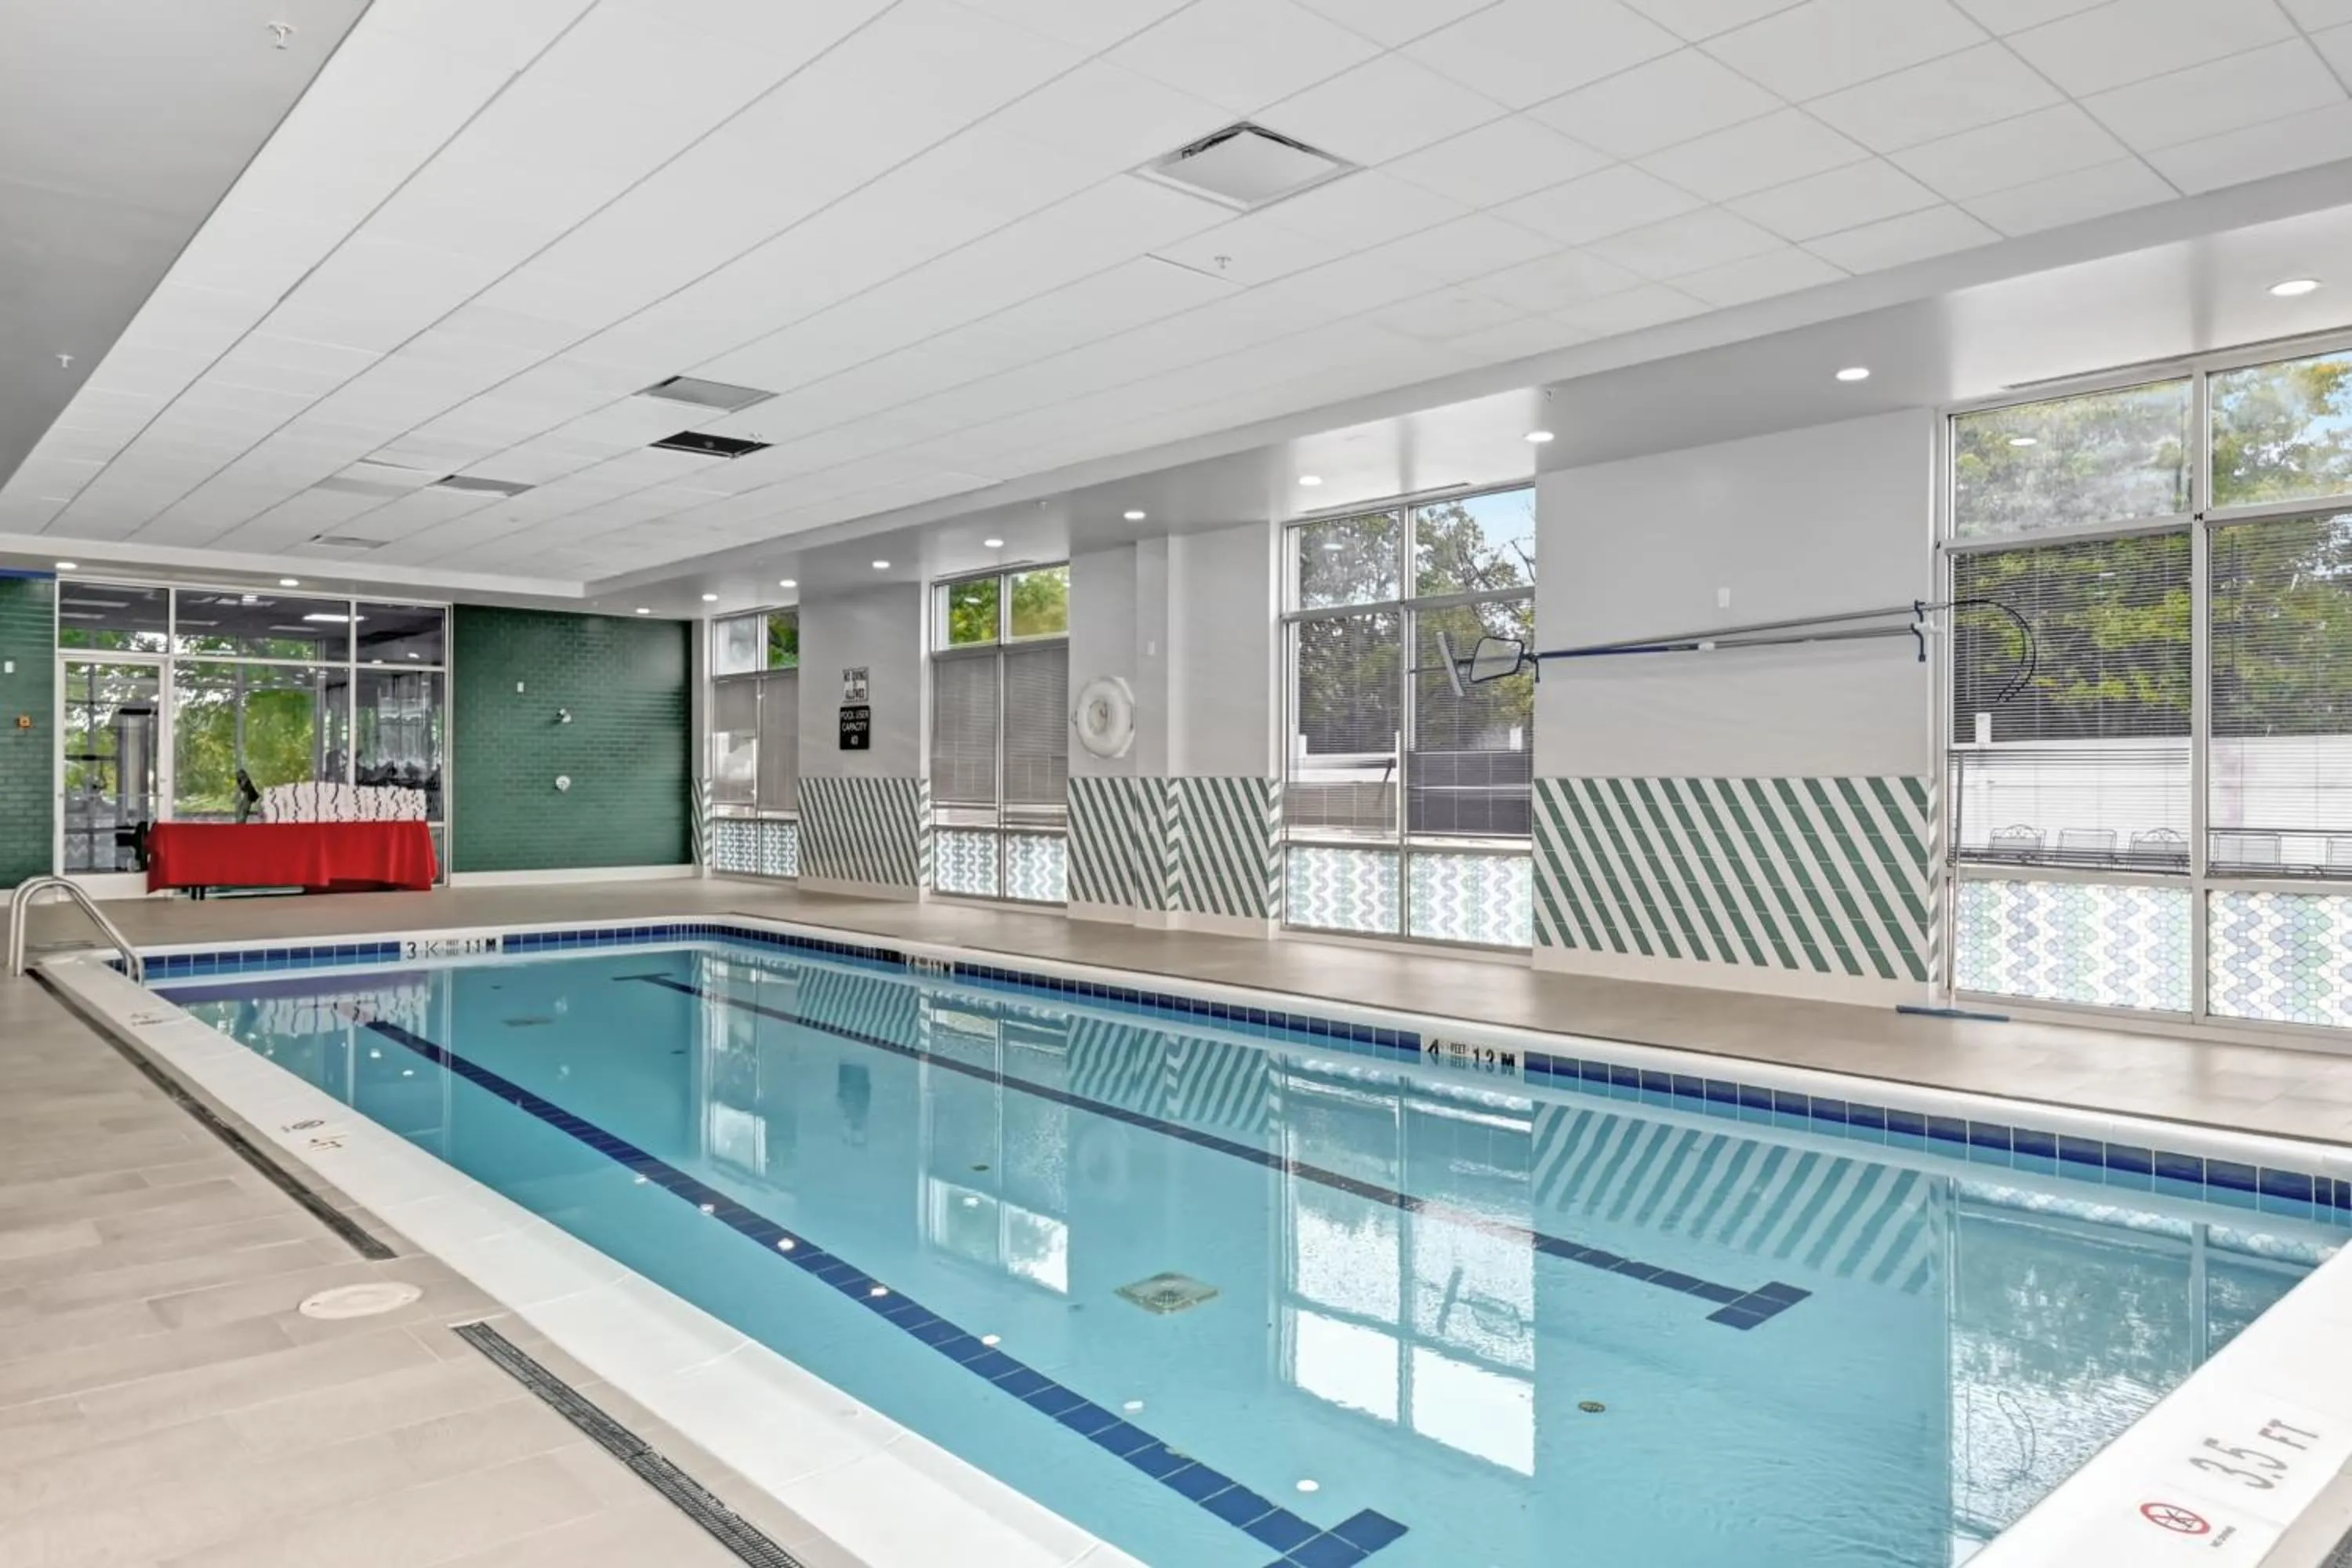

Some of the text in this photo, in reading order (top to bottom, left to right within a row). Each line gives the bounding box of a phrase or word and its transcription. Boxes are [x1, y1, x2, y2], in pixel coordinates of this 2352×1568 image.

[841, 709, 869, 720] POOL USER
[842, 721, 867, 731] CAPACITY
[2188, 1418, 2319, 1490] 3.5 FT
